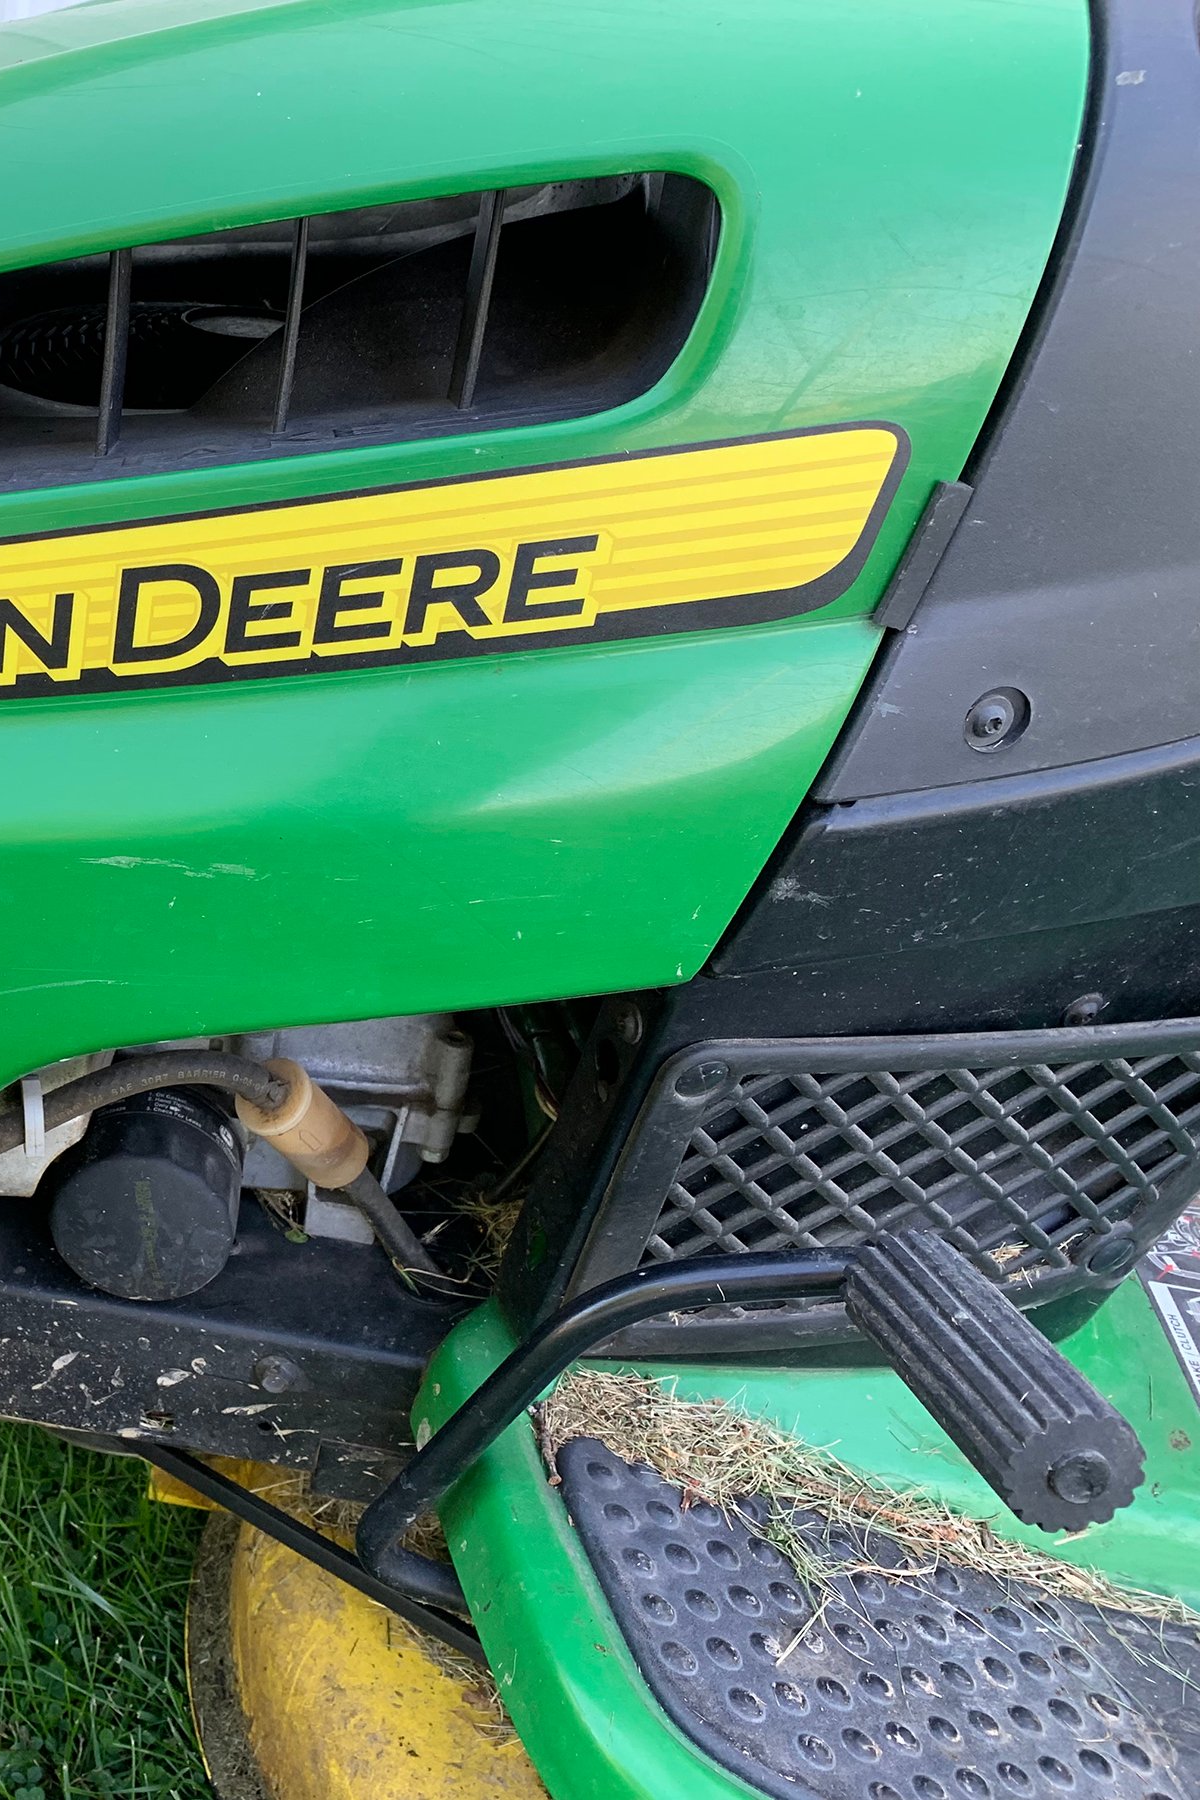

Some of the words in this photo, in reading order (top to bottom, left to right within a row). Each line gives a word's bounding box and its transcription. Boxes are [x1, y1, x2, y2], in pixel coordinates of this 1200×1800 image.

[118, 533, 602, 663] DEERE
[110, 1082, 133, 1096] SAE
[177, 1070, 226, 1081] BARRIER
[1166, 1313, 1192, 1351] CLUTCH
